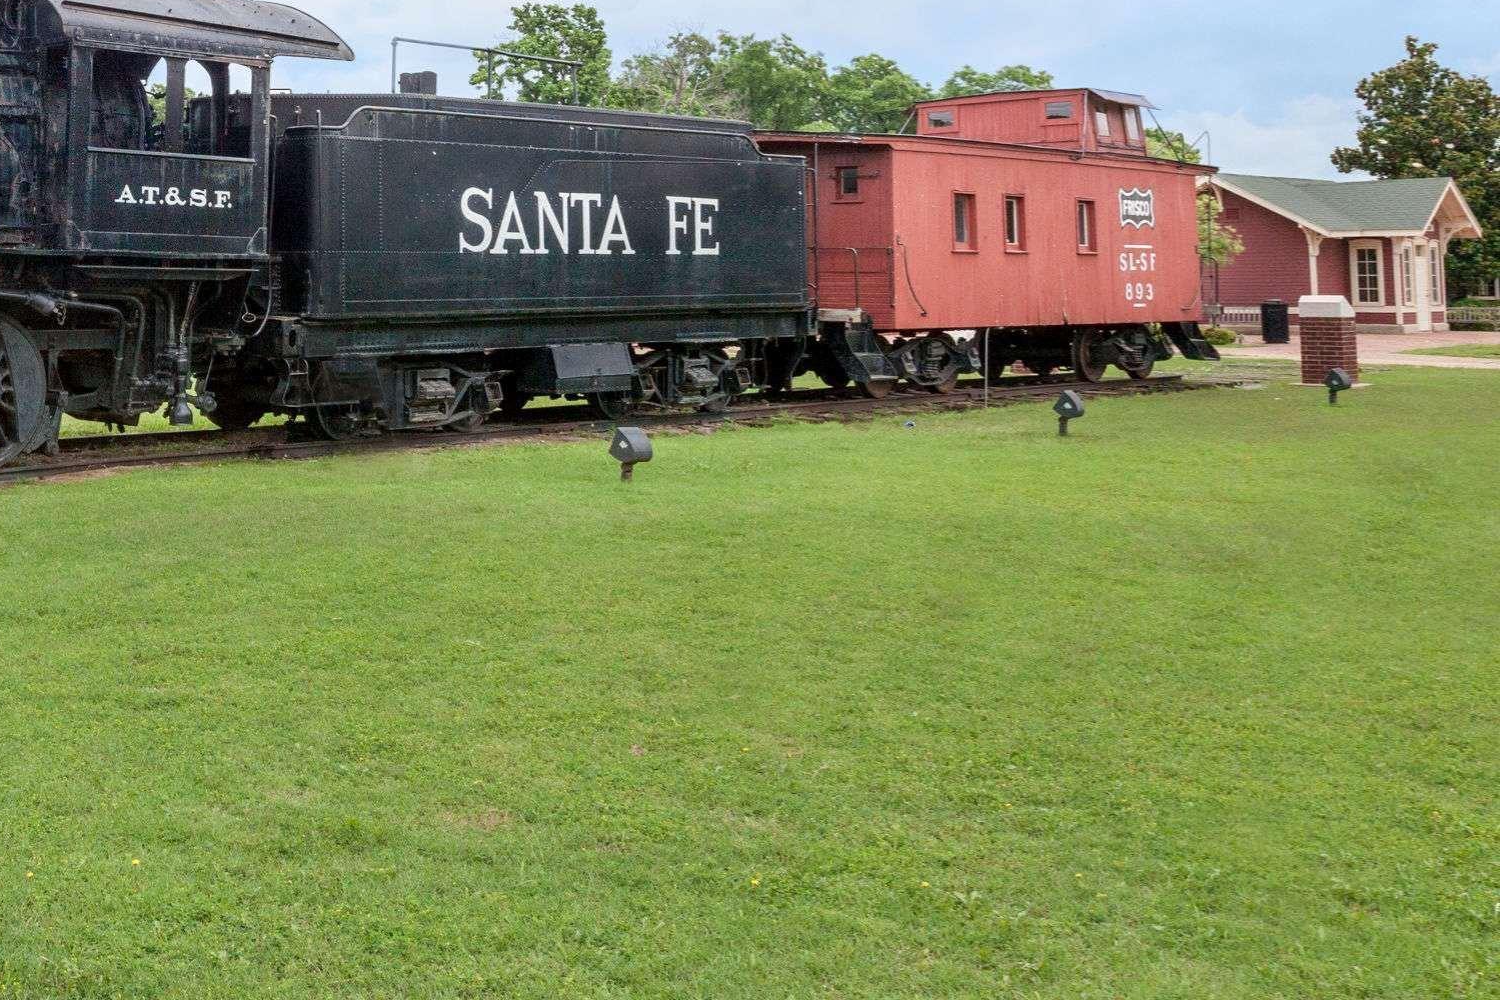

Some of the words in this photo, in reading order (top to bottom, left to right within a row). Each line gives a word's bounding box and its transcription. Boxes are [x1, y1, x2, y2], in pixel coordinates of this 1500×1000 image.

[1122, 199, 1150, 216] FRISCO
[458, 186, 636, 255] SANTA
[665, 195, 720, 255] FE
[1119, 252, 1156, 271] SL-SF
[1125, 282, 1154, 300] 893
